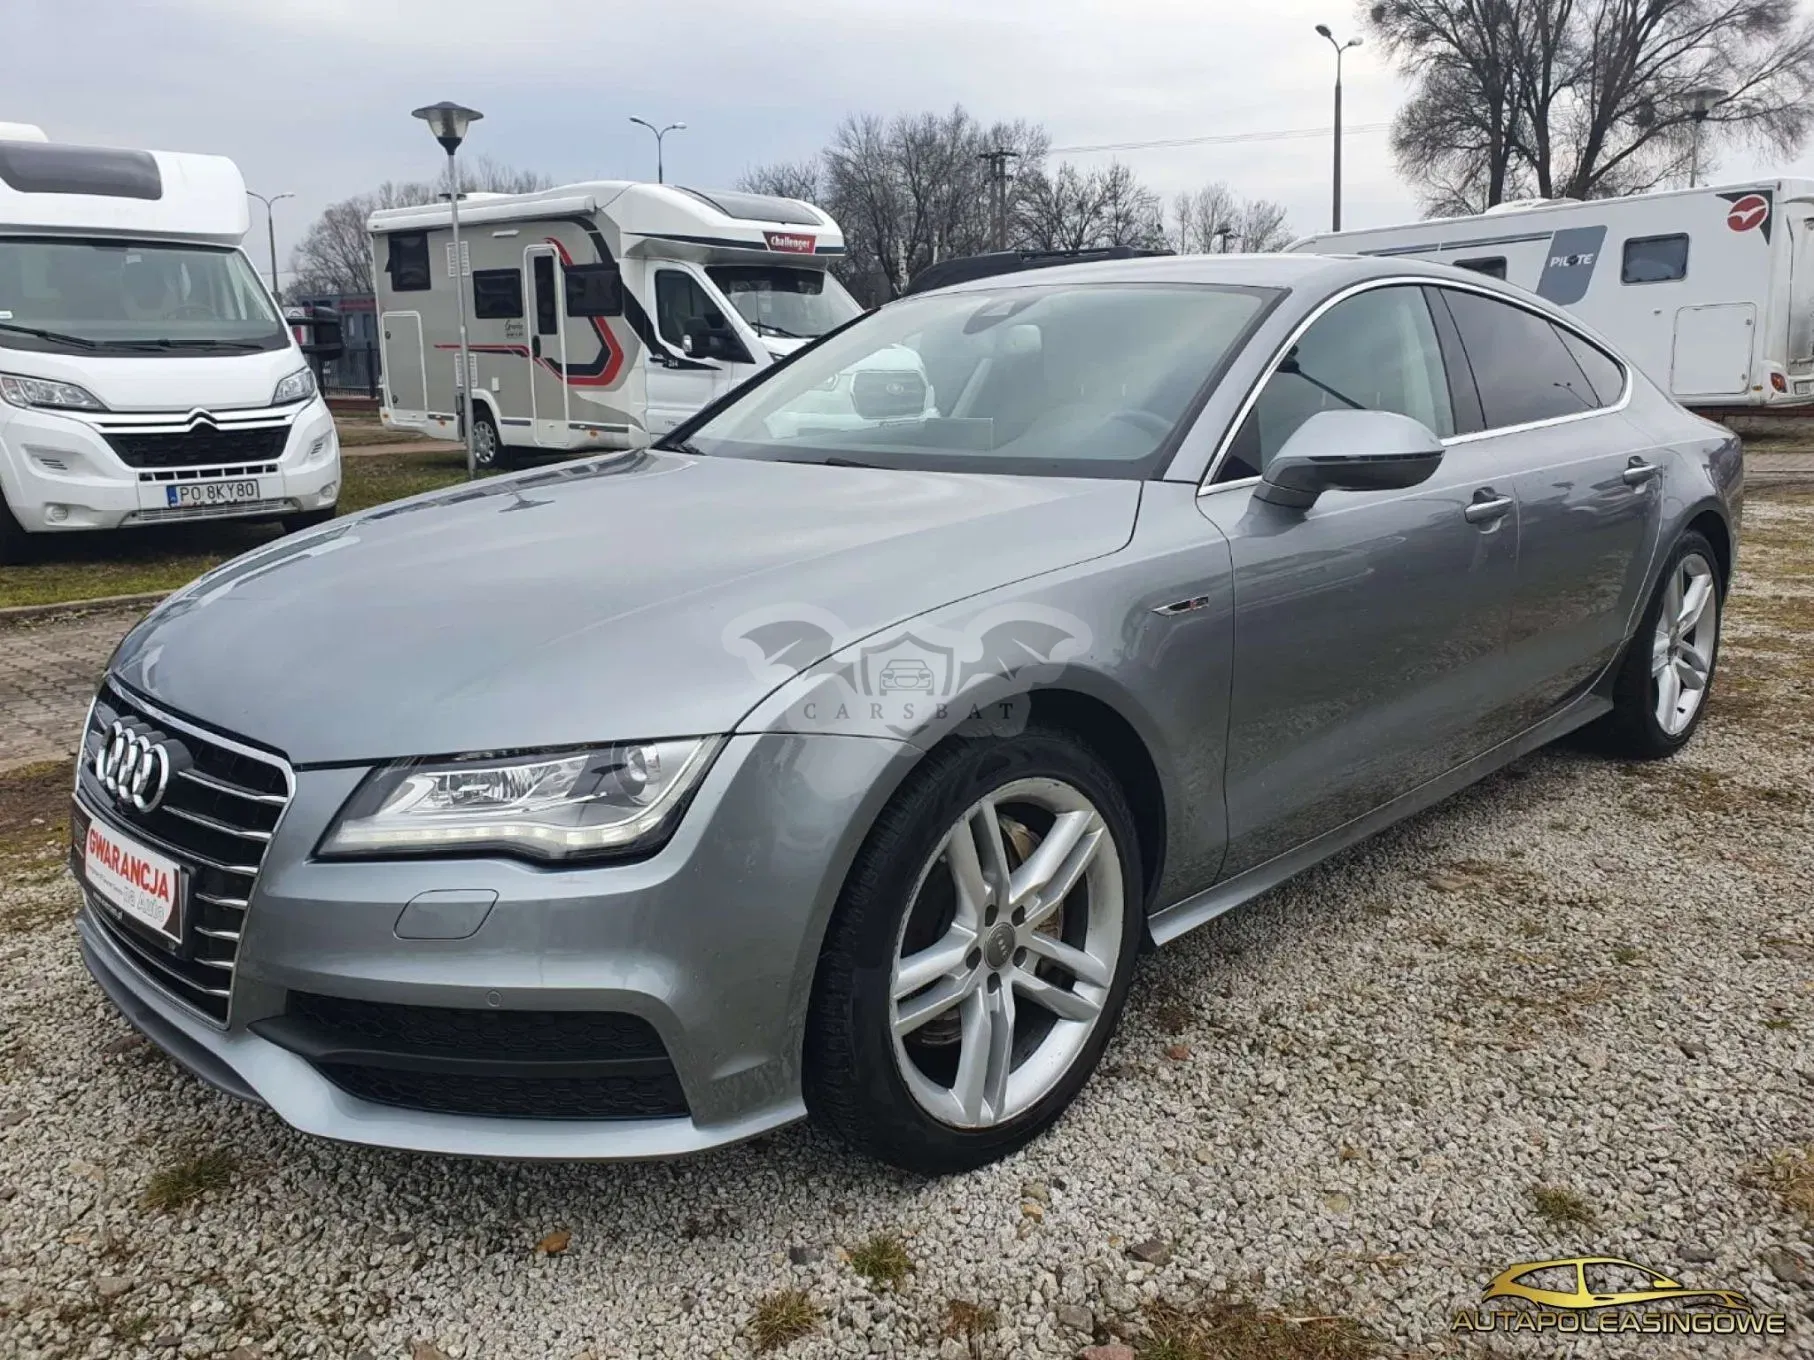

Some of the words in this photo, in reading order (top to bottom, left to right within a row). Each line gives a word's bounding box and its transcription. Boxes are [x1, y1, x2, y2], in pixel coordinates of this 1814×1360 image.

[770, 235, 810, 251] Challenger
[1550, 253, 1594, 268] PILOTE
[180, 486, 201, 501] PO
[207, 482, 255, 499] 8KY80
[88, 829, 169, 903] GWARANCJA
